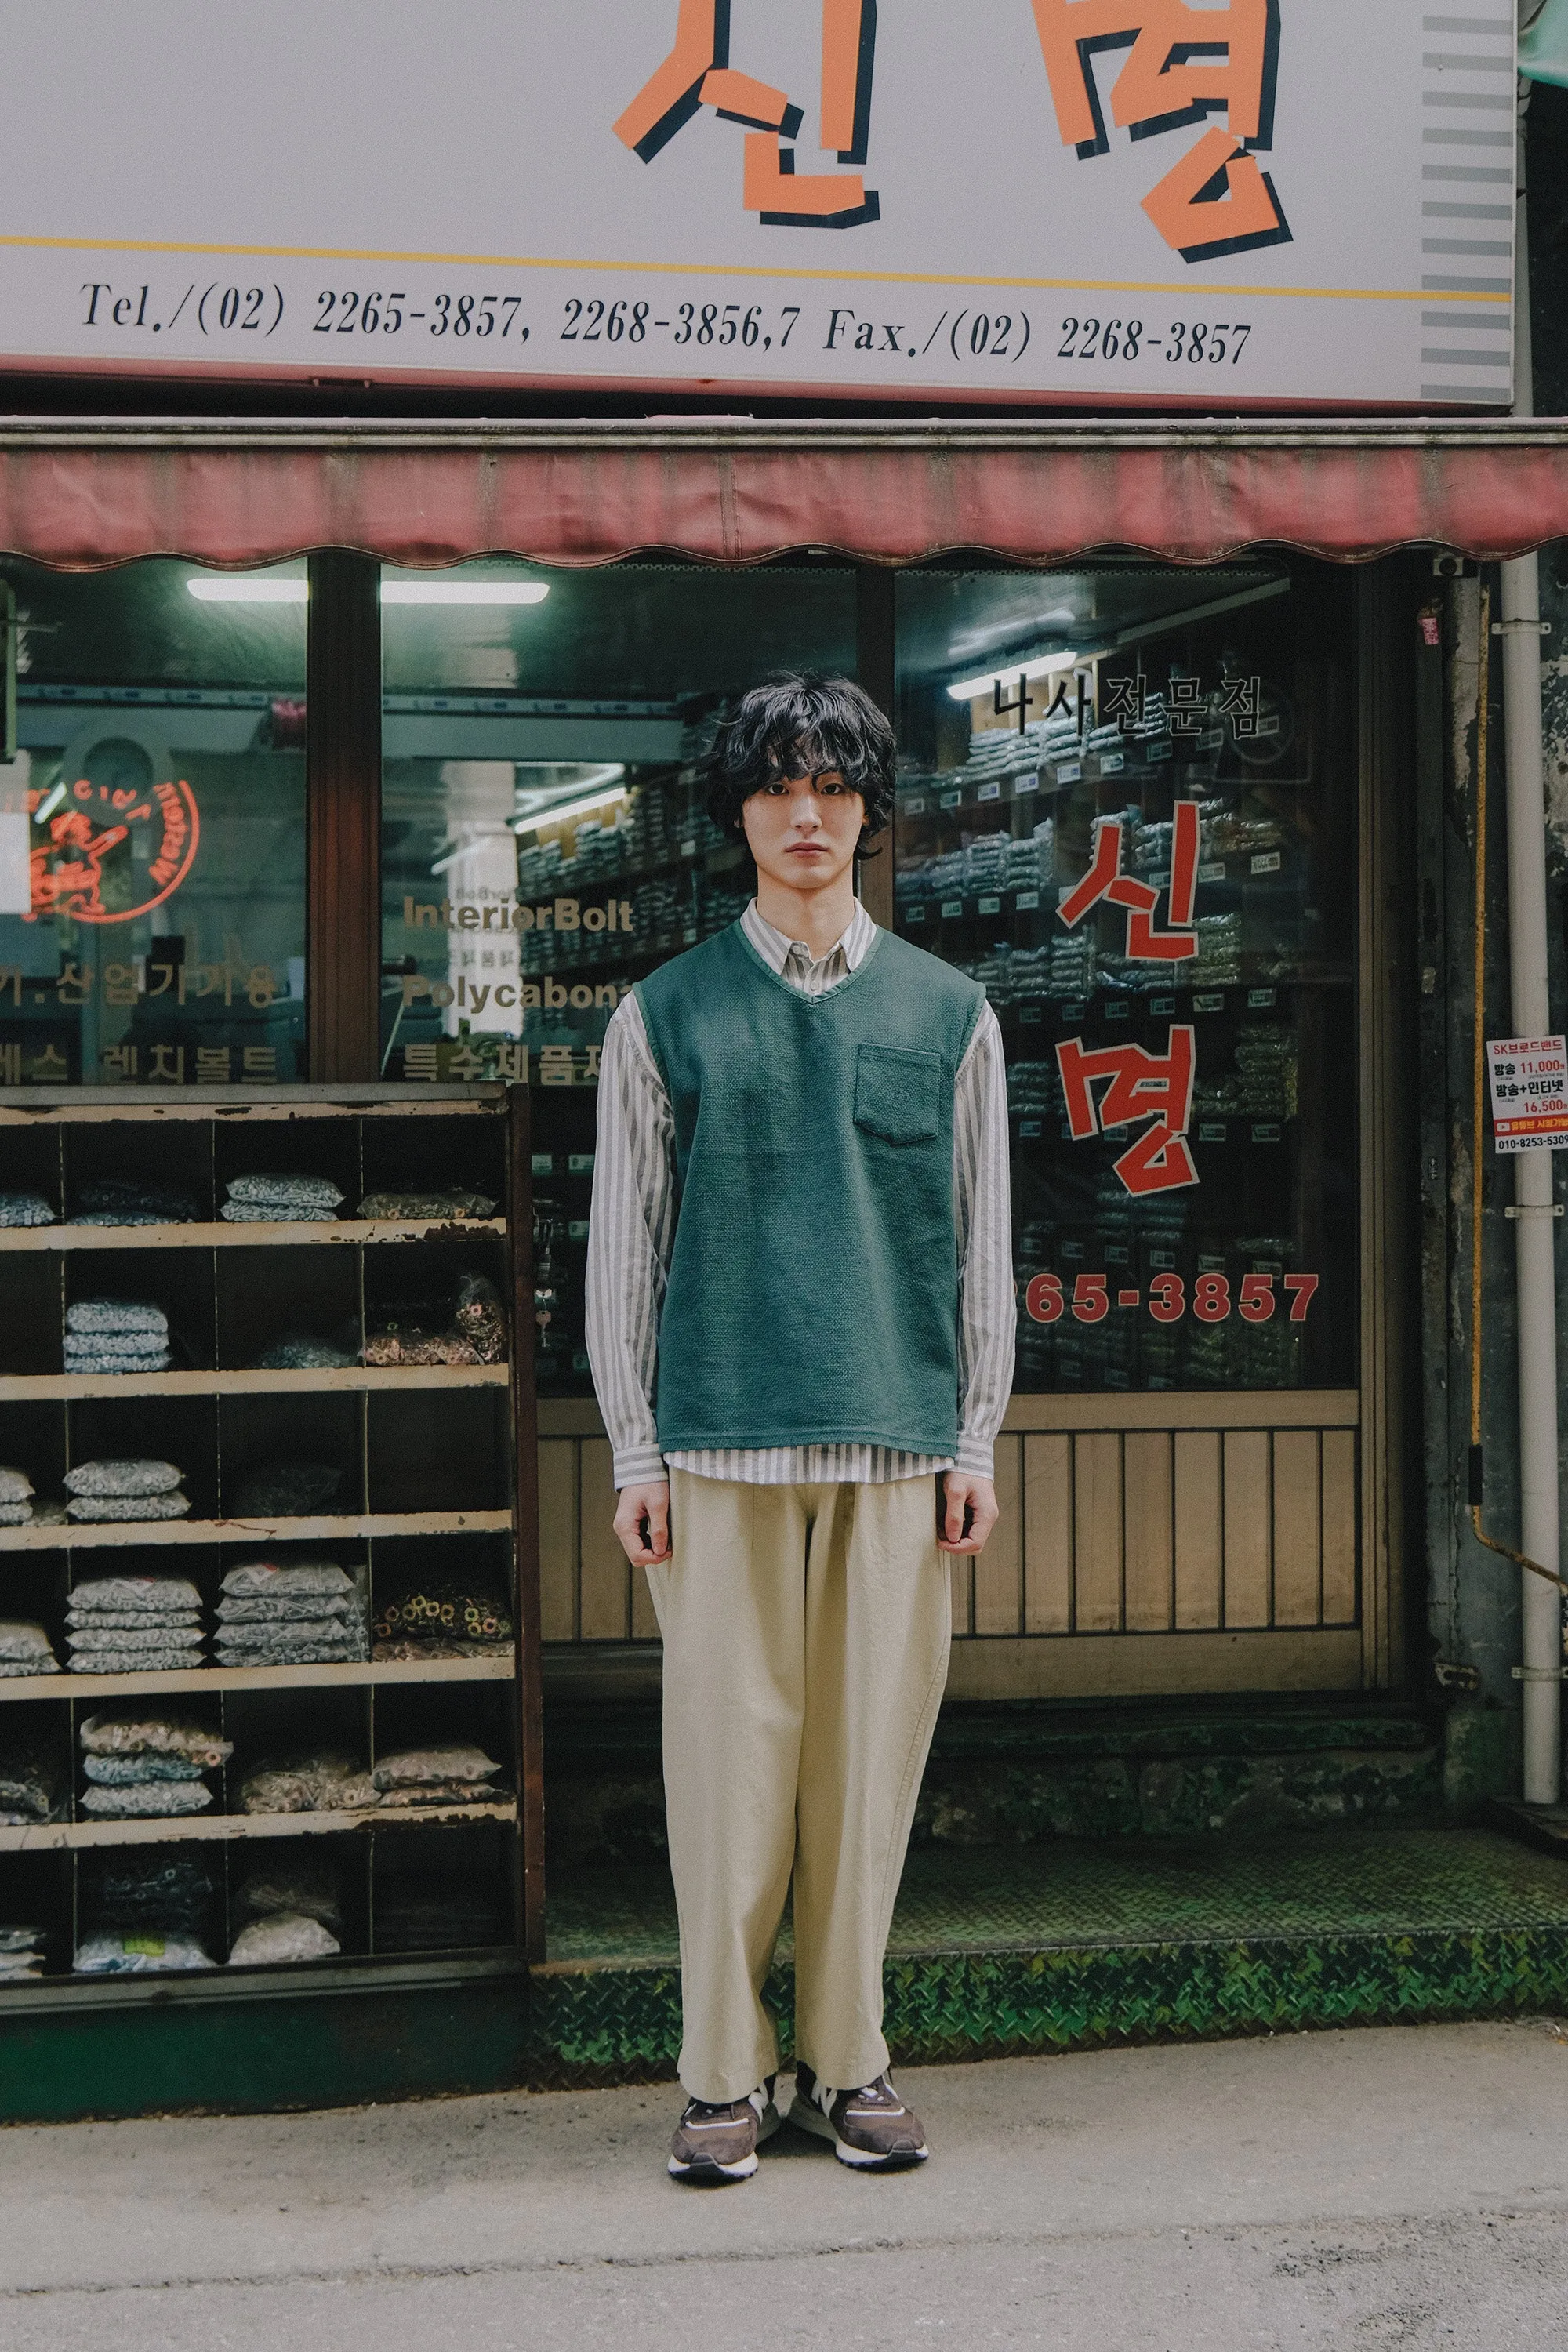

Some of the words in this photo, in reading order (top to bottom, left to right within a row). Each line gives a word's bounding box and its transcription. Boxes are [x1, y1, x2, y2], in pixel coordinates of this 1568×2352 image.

[82, 282, 285, 337] Tel./(02)
[313, 290, 530, 343] 2265-3857,
[822, 308, 1031, 363] Fax./(02)
[1057, 318, 1252, 365] 2268-3857
[403, 896, 633, 931] InteriorBolt
[402, 975, 633, 1014] Polycabon
[1494, 1040, 1563, 1055] SK브로드밴드
[1494, 1063, 1515, 1076] 방송
[1013, 1273, 1319, 1323] 65-3857
